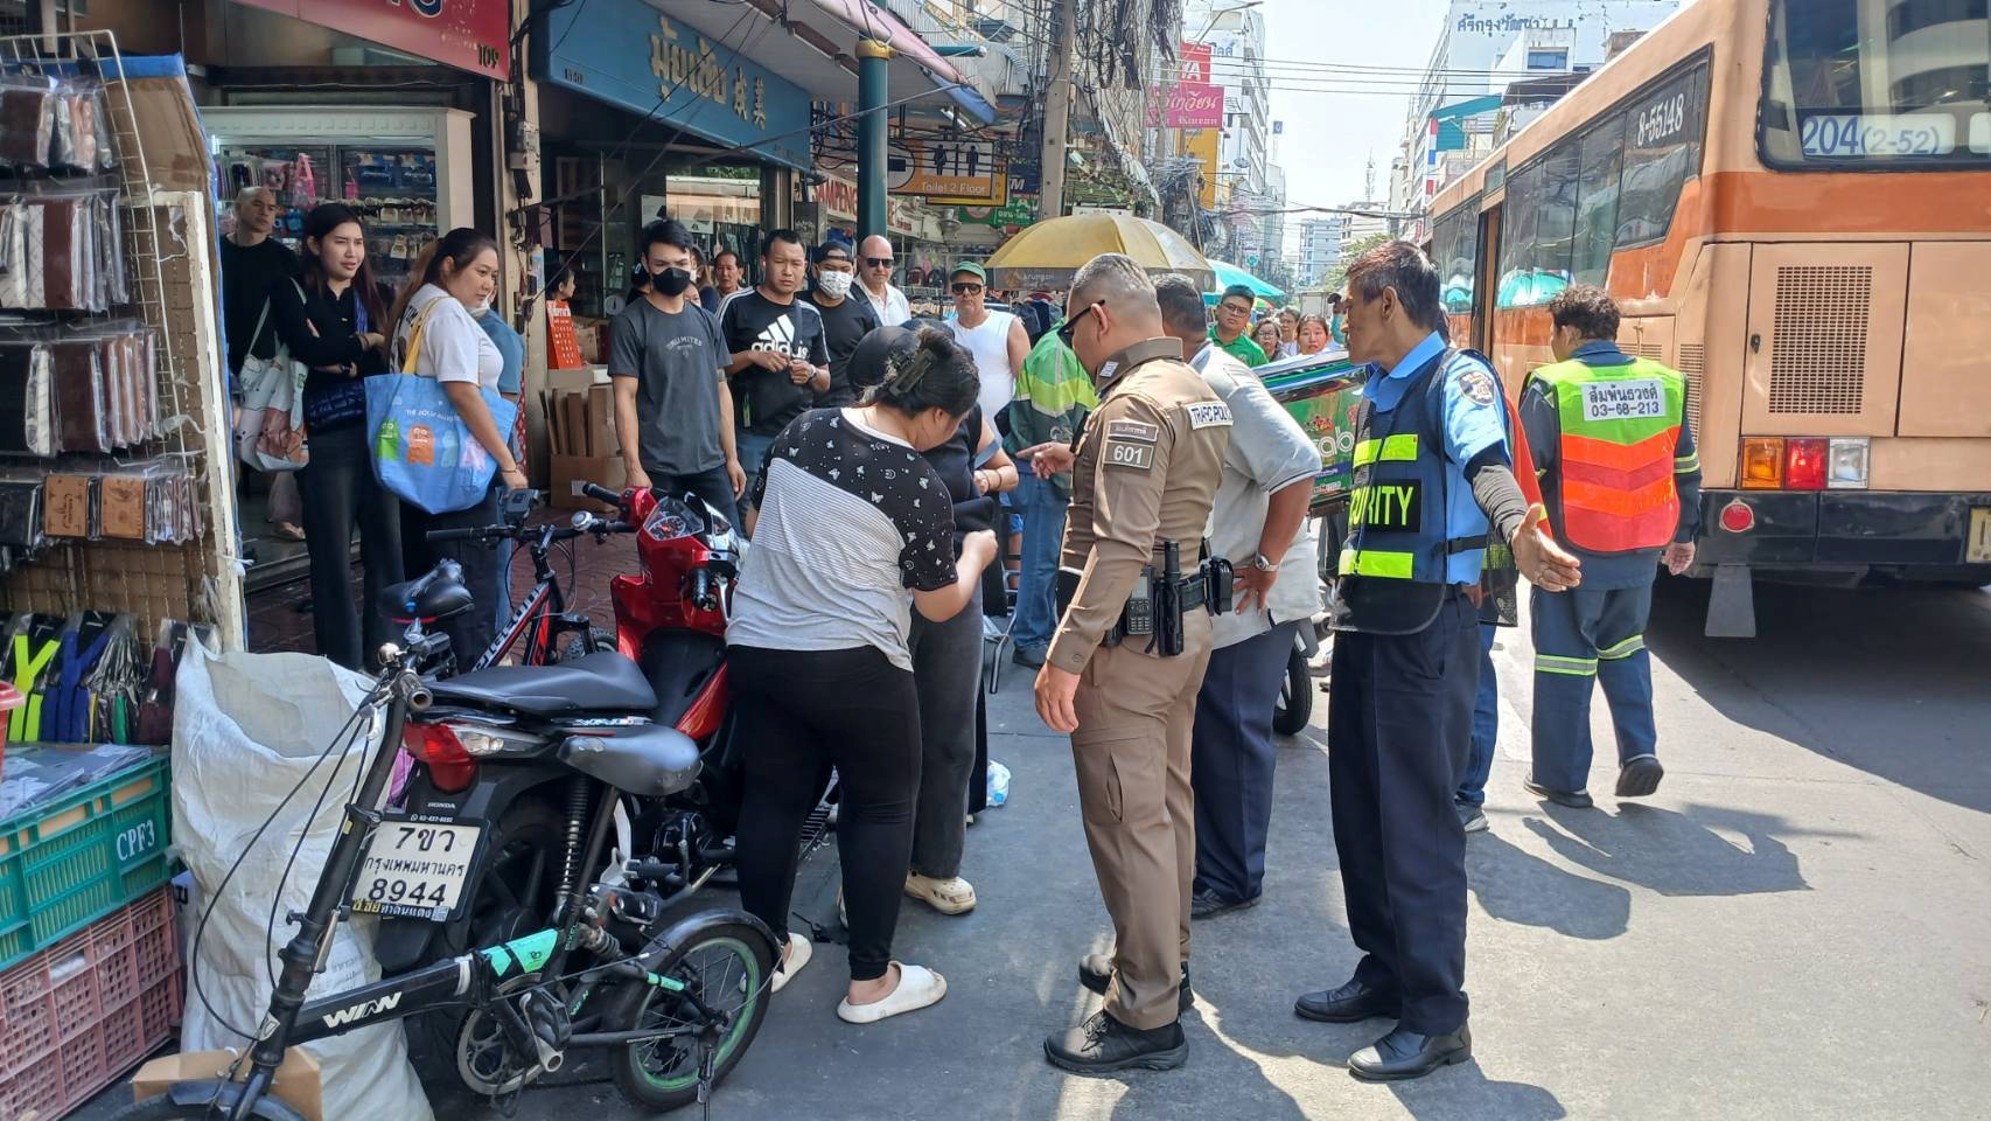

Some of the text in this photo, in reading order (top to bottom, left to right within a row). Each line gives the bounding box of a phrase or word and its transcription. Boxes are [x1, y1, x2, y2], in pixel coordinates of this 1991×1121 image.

[477, 44, 500, 69] 109
[1637, 93, 1684, 147] 8-55148
[920, 181, 986, 194] Toilet 2 Floor
[1590, 401, 1660, 418] 03-68-213
[1113, 445, 1143, 464] 601
[427, 801, 456, 810] HONDA
[116, 819, 155, 862] CPF3
[364, 857, 466, 877] กรุงเทพมหานคร
[367, 878, 448, 907] 8944
